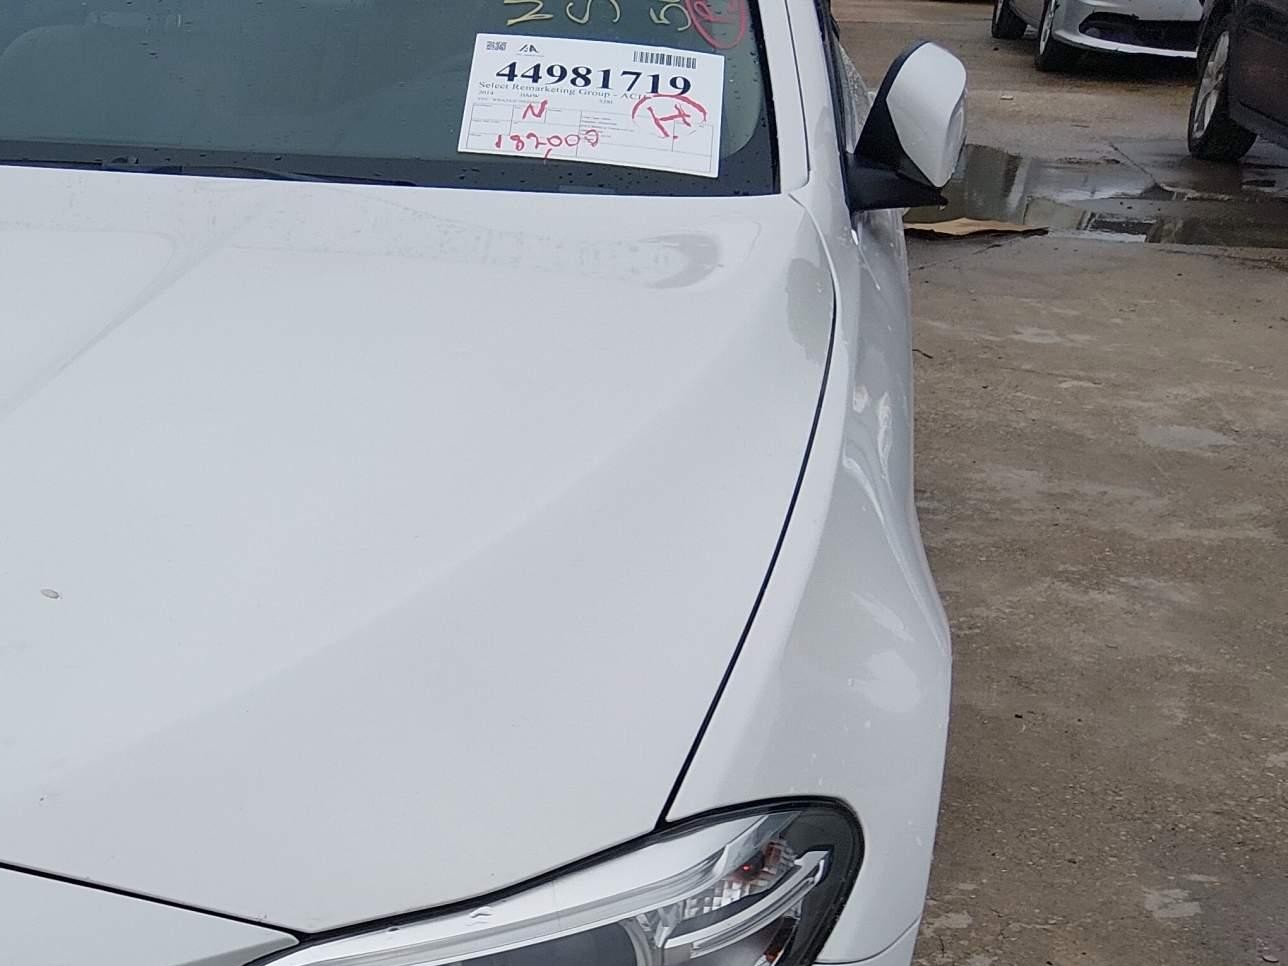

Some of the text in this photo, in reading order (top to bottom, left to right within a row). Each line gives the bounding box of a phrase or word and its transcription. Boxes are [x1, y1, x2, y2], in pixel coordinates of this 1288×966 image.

[479, 81, 509, 90] Select
[512, 84, 576, 95] Remarketing
[578, 89, 610, 98] Group
[495, 61, 691, 96] 44981719
